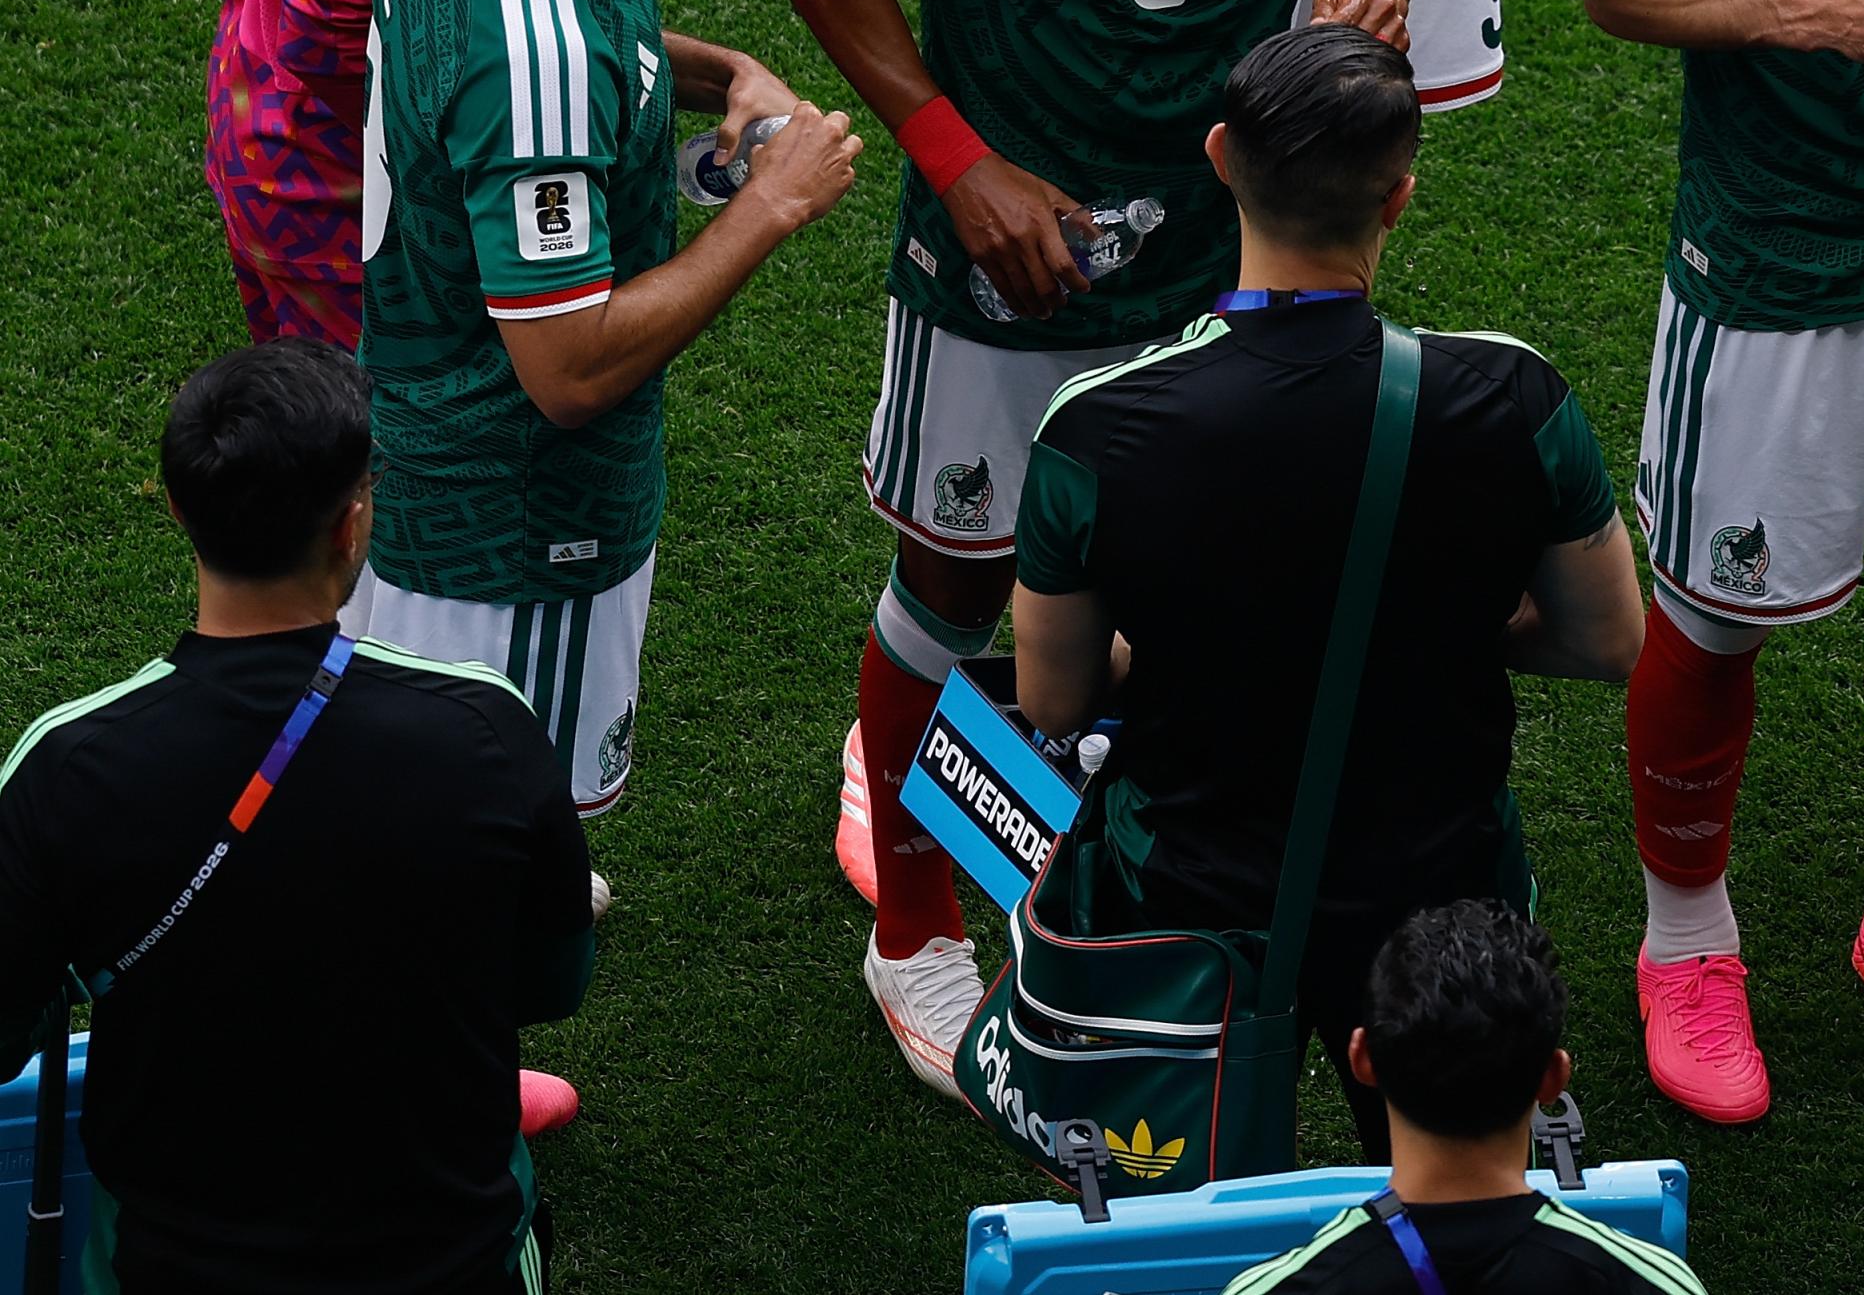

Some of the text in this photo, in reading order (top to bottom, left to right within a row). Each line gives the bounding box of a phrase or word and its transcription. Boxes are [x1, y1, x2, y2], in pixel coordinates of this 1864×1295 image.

[547, 223, 563, 231] FIFA
[540, 241, 573, 252] 2026
[936, 512, 985, 528] MÉXICO
[1713, 573, 1762, 592] MÉXICO
[926, 727, 1052, 873] POWERADE
[117, 842, 229, 970] FIFA WORLD CUP 2026
[977, 1015, 1058, 1158] adida
